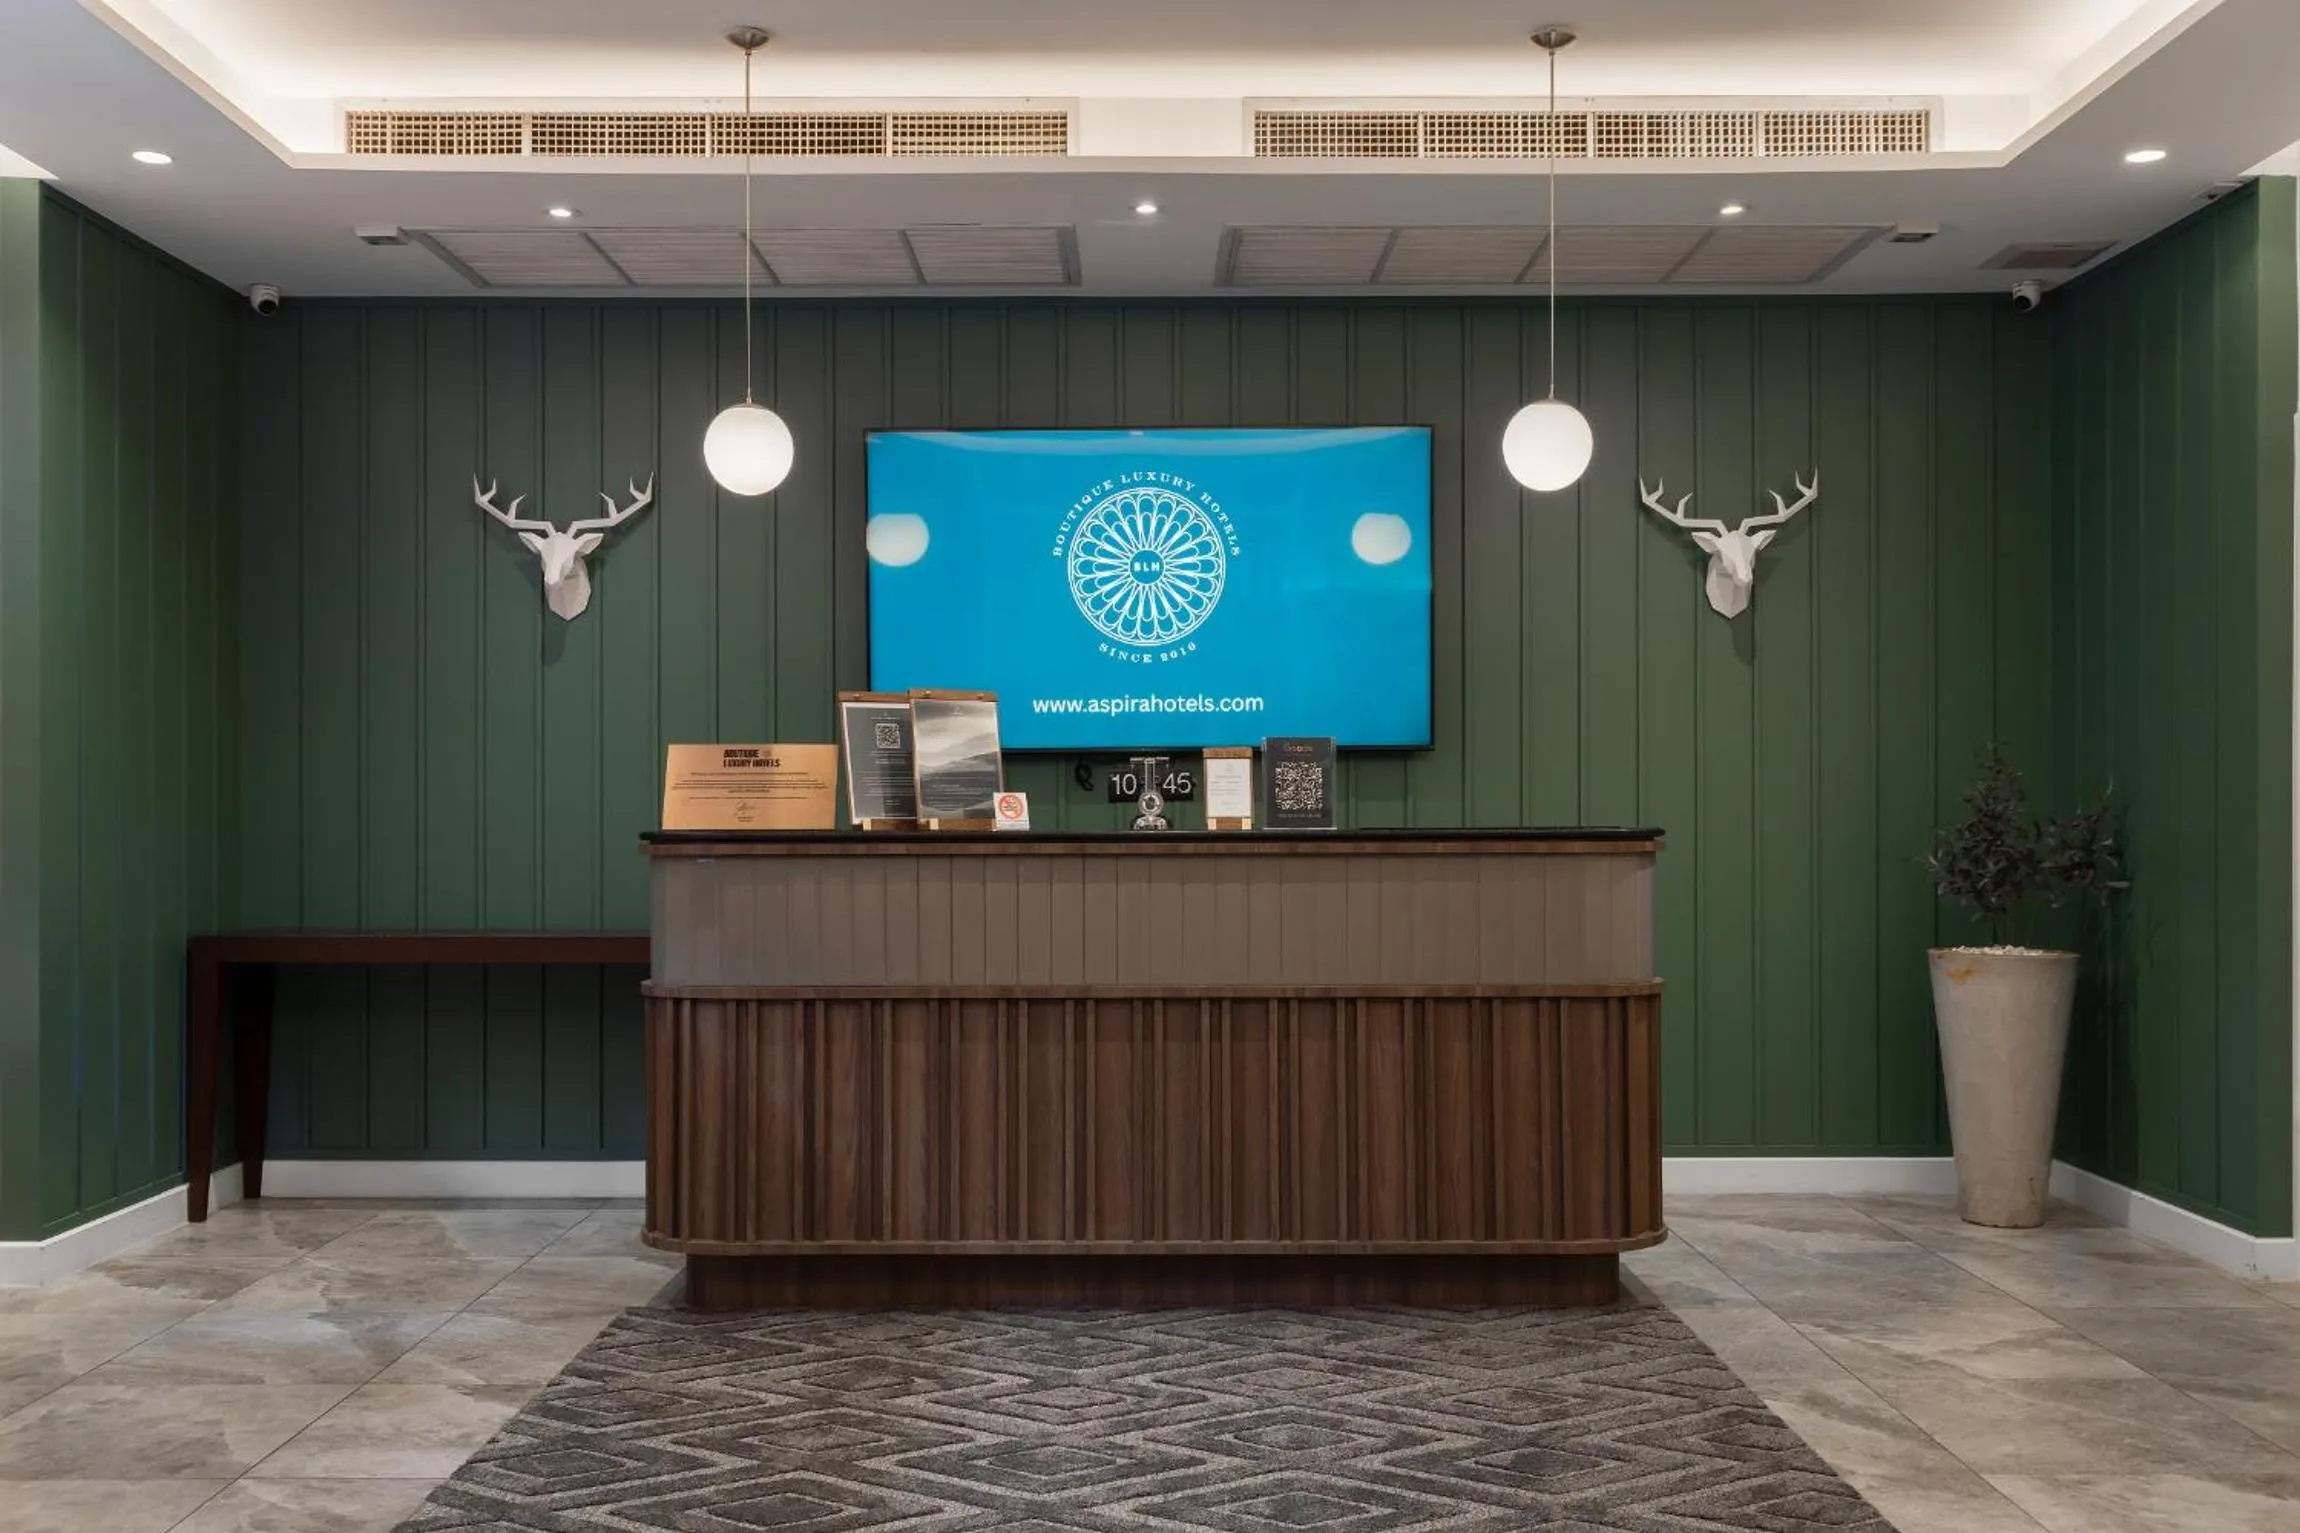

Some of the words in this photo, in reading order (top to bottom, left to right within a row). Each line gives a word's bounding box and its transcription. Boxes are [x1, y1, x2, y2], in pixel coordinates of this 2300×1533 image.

[1052, 479, 1114, 557] BOUTIQUE
[1120, 471, 1196, 492] LUXURY
[1199, 491, 1241, 557] HOTELS
[1133, 561, 1161, 572] BLH
[1098, 642, 1153, 664] SINCE
[1159, 641, 1198, 662] 2010
[1033, 693, 1264, 718] www.aspirahotels.com
[1111, 773, 1137, 795] 10
[1162, 771, 1192, 794] 45
